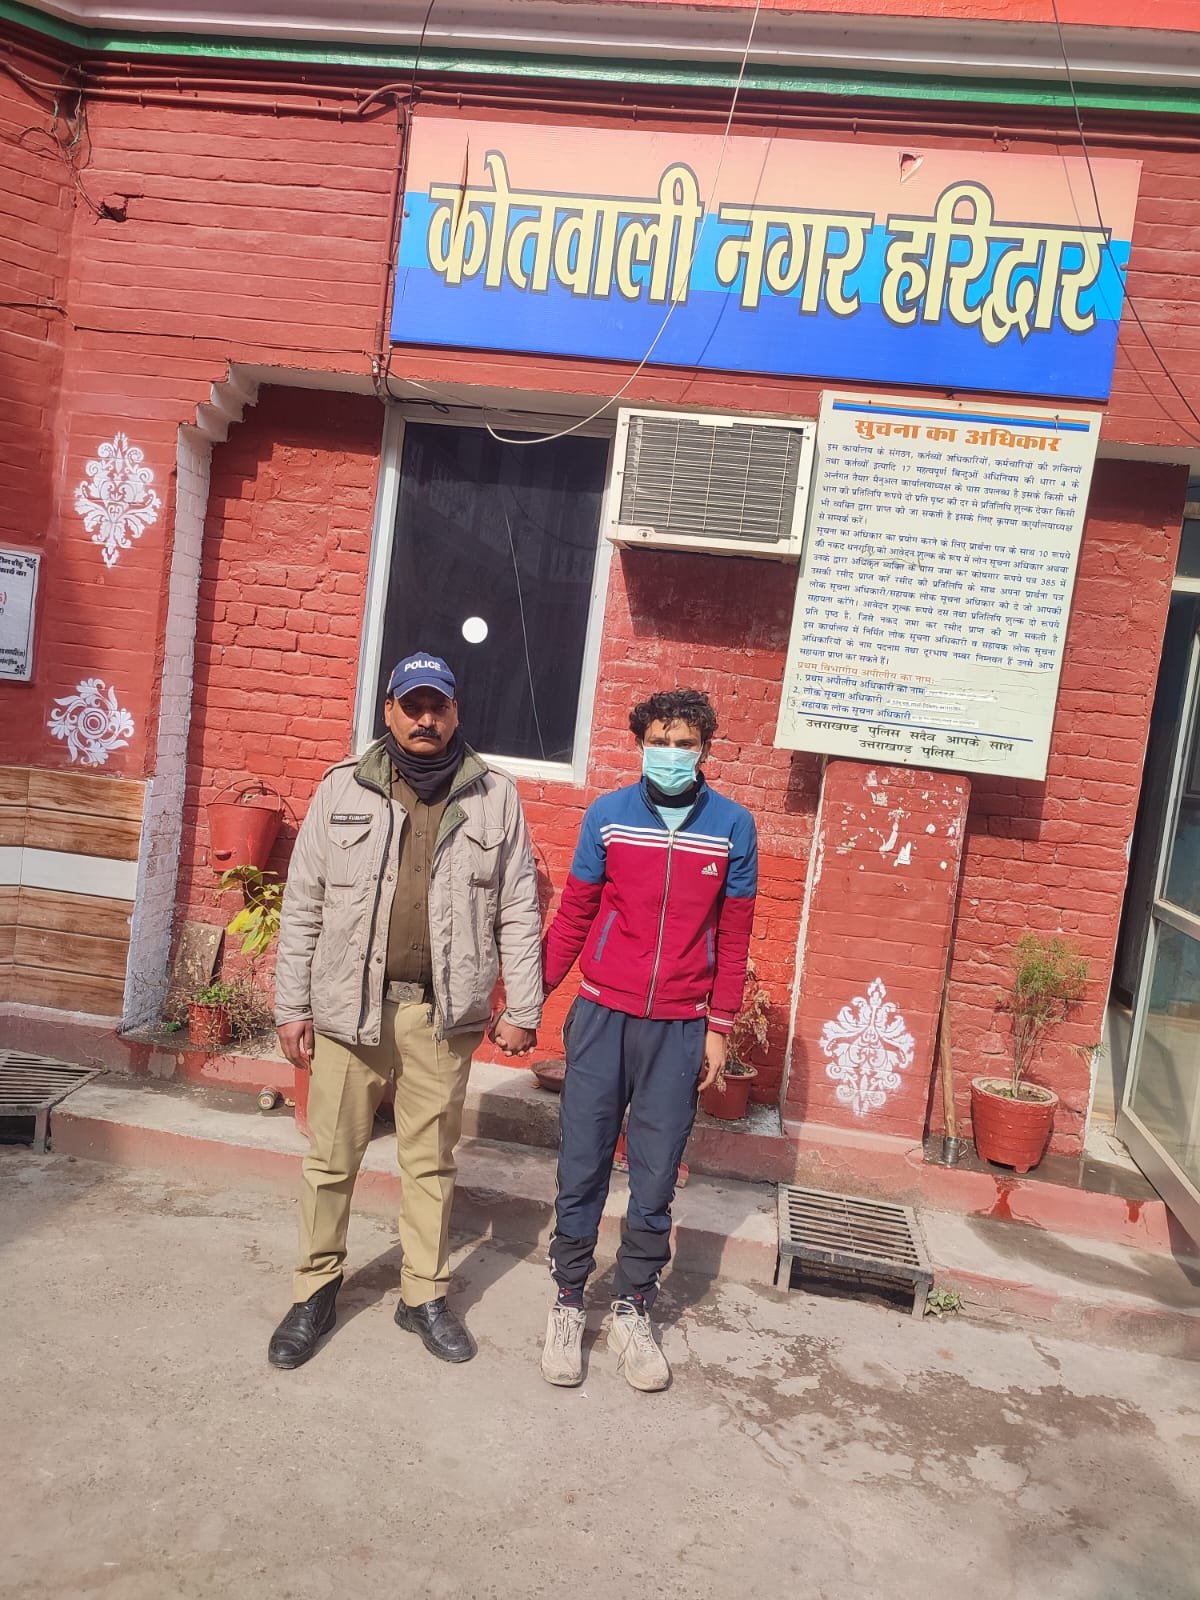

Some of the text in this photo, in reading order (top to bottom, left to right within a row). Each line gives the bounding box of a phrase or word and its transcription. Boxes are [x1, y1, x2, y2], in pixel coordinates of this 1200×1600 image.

[427, 149, 1112, 347] कोतवाली नगर हरिद्वार
[853, 419, 1060, 452] सुचना का अधिकार
[842, 442, 873, 454] कार्यालय
[825, 457, 840, 465] तथा
[872, 460, 896, 471] इत्यादि
[901, 464, 911, 472] 17
[965, 485, 980, 493] पास
[913, 492, 928, 503] प्रति
[1012, 504, 1033, 515] शुल्क
[815, 526, 837, 537] सूचना
[852, 528, 883, 540] अधिकार
[919, 535, 938, 546] करने
[949, 538, 967, 551] लिए
[1018, 547, 1035, 558] साथ
[1039, 549, 1049, 557] 10
[1012, 558, 1044, 571] अधिकार
[1040, 578, 1056, 586] 385
[828, 582, 850, 594] सूचना
[938, 595, 961, 607] सूचना
[891, 603, 911, 614] शुल्क
[936, 608, 949, 616] दस
[817, 620, 849, 632] कार्यालय
[1032, 647, 1056, 659] सूचना
[857, 641, 872, 649] नाम
[404, 660, 441, 672] POLICE
[848, 690, 882, 705] अधिकारी
[830, 701, 850, 713] लोक
[850, 706, 874, 718] सूचना
[876, 707, 911, 720] अधिकारी
[805, 718, 1014, 752] उत्तराखण्ड पुलिस सदैव आपके साथ
[857, 739, 955, 761] उत्तराखण्ड पुलिस
